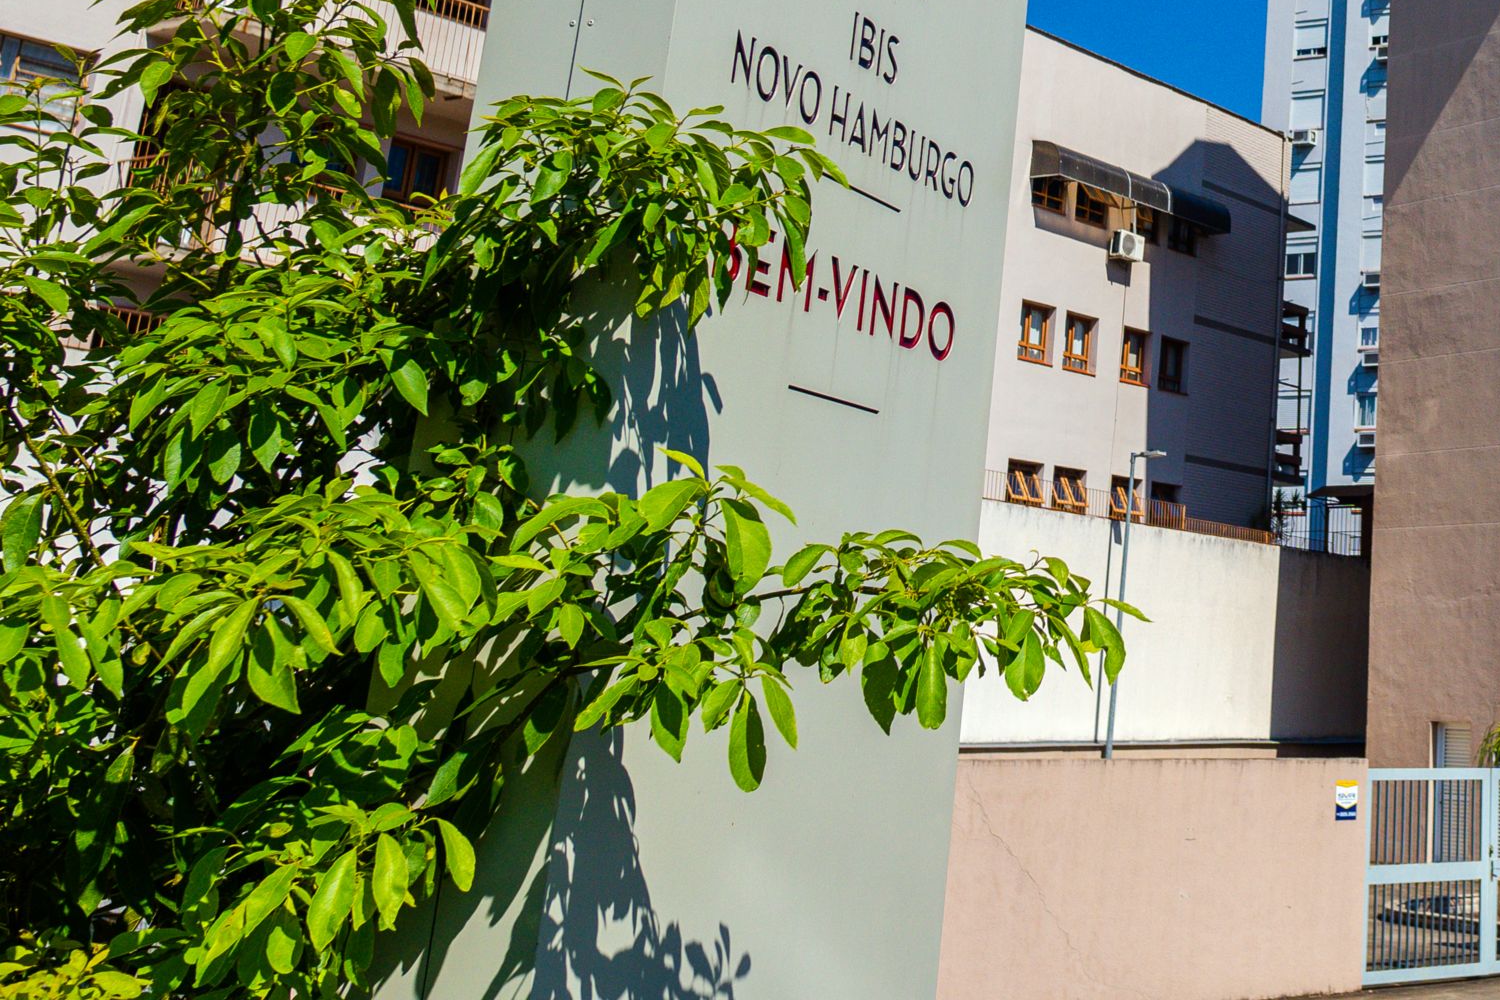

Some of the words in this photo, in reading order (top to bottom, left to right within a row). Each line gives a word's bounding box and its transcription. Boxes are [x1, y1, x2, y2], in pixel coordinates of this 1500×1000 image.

[849, 11, 900, 86] IBIS
[730, 29, 823, 127] NOVO
[828, 85, 975, 209] HAMBURGO
